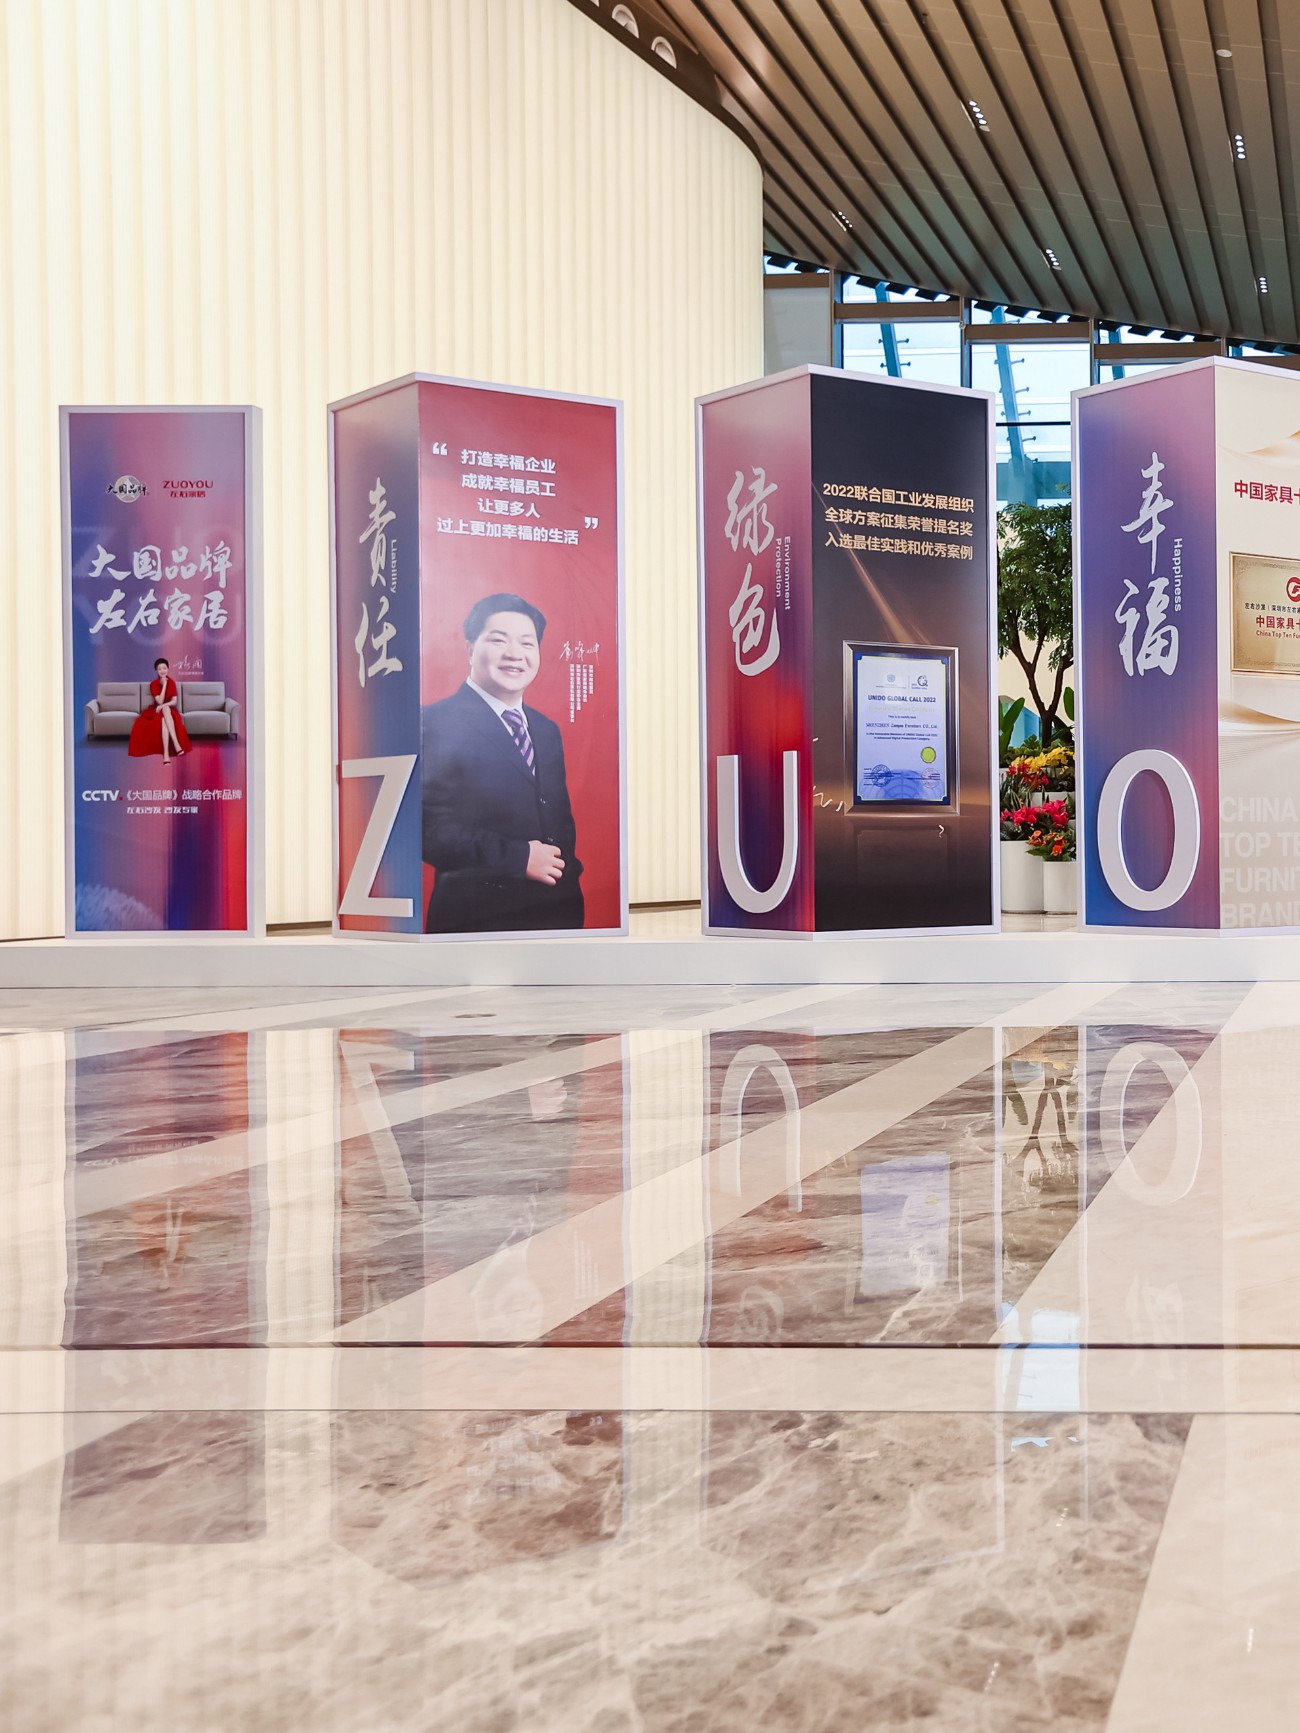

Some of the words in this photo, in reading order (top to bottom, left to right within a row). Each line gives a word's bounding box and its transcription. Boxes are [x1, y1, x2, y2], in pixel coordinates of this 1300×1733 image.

[460, 449, 556, 474] 打造幸福企业
[162, 480, 214, 489] ZUOYOU
[461, 473, 556, 497] 成就幸福员工
[822, 483, 975, 513] 2022联合国工业发展组织
[477, 499, 541, 519] 让更多人
[824, 507, 973, 537] 全球方案征集荣誉提名奖
[436, 517, 579, 545] 过上更加幸福的生活
[824, 531, 973, 561] 入选最佳实践和优秀案例
[88, 540, 233, 588] 大国品牌
[389, 538, 398, 594] Liability
[724, 465, 781, 677] 绿色
[775, 537, 783, 598] Protection
[783, 535, 792, 610] Environment
[1114, 451, 1180, 678] 幸福
[1173, 537, 1183, 612] Happiness
[88, 587, 229, 634] 左右家居
[1255, 629, 1271, 637] China
[1272, 630, 1282, 638] Top
[867, 694, 886, 702] UNIDO
[81, 789, 120, 801] CCTV
[1219, 796, 1299, 823] CHINA
[337, 753, 418, 918] Z
[716, 750, 799, 914] U
[1096, 748, 1201, 912] O
[1219, 831, 1272, 858] TOP
